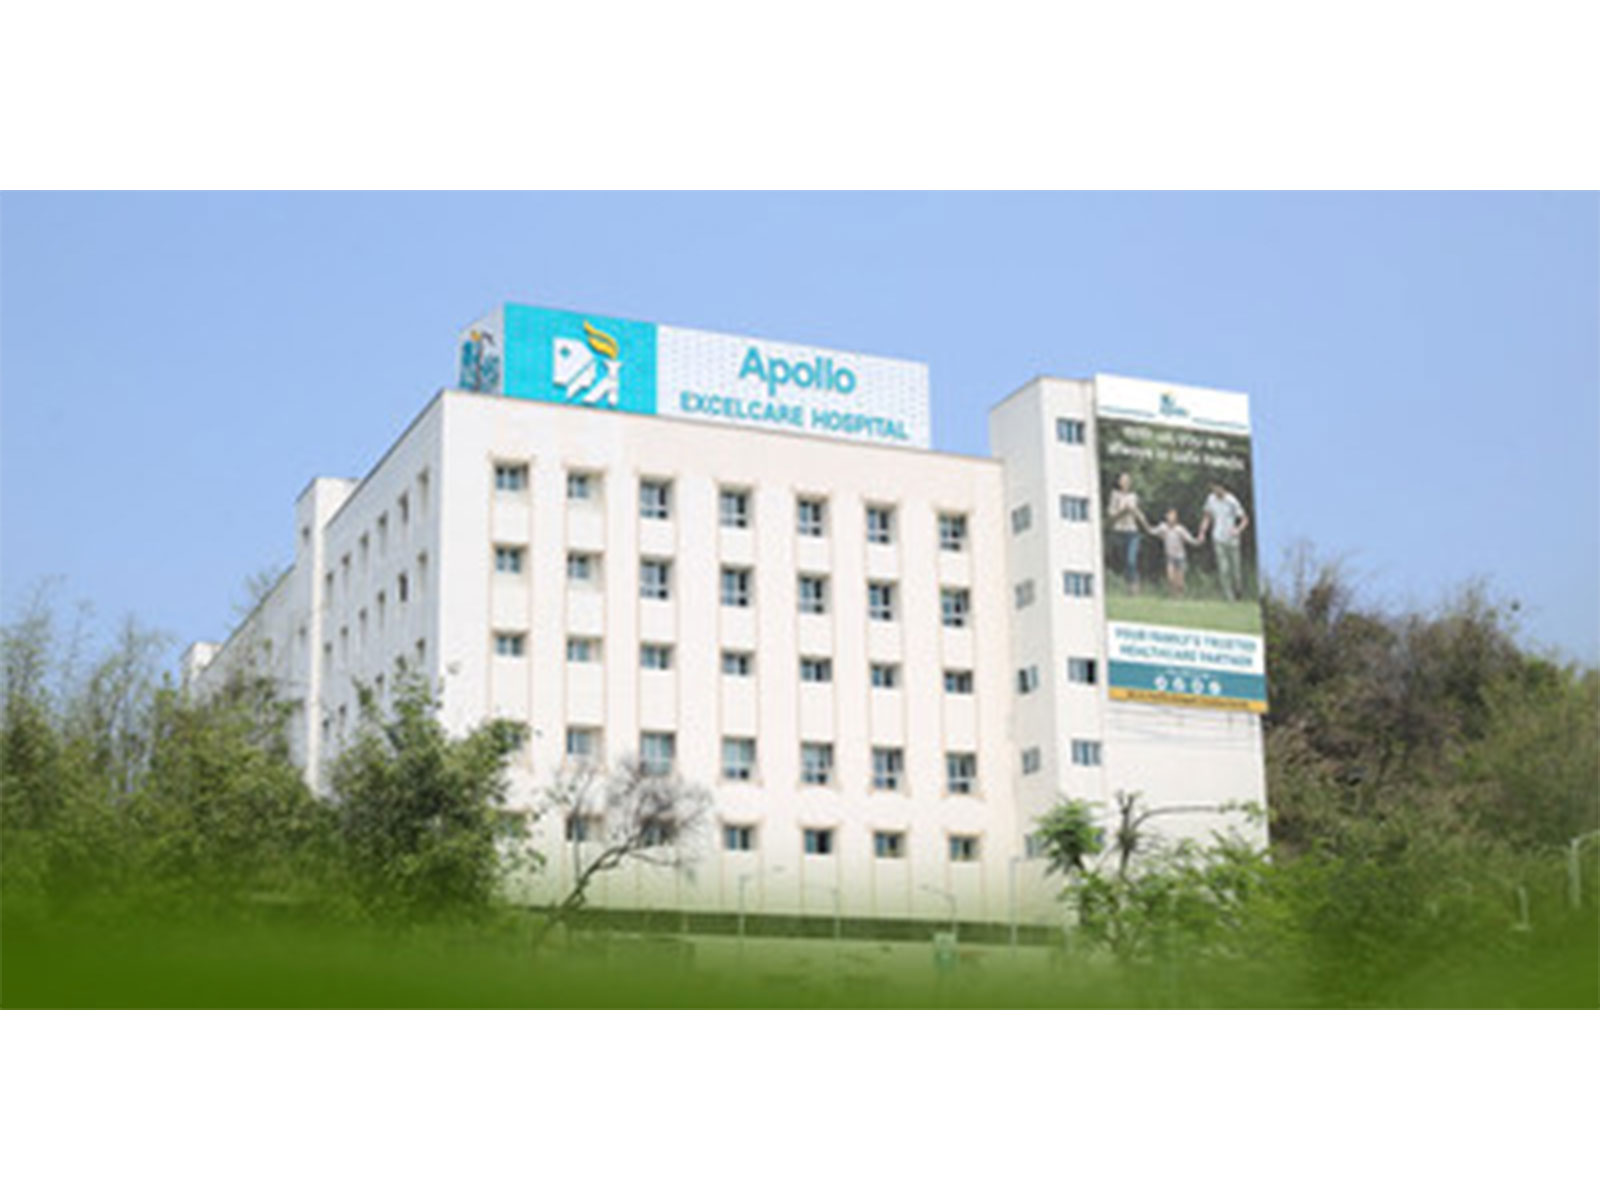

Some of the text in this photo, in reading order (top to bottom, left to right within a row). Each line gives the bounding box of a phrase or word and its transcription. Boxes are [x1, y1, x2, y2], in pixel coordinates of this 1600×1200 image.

[738, 346, 857, 397] Apollo
[679, 390, 909, 440] EXCELCARE HOSPITAL
